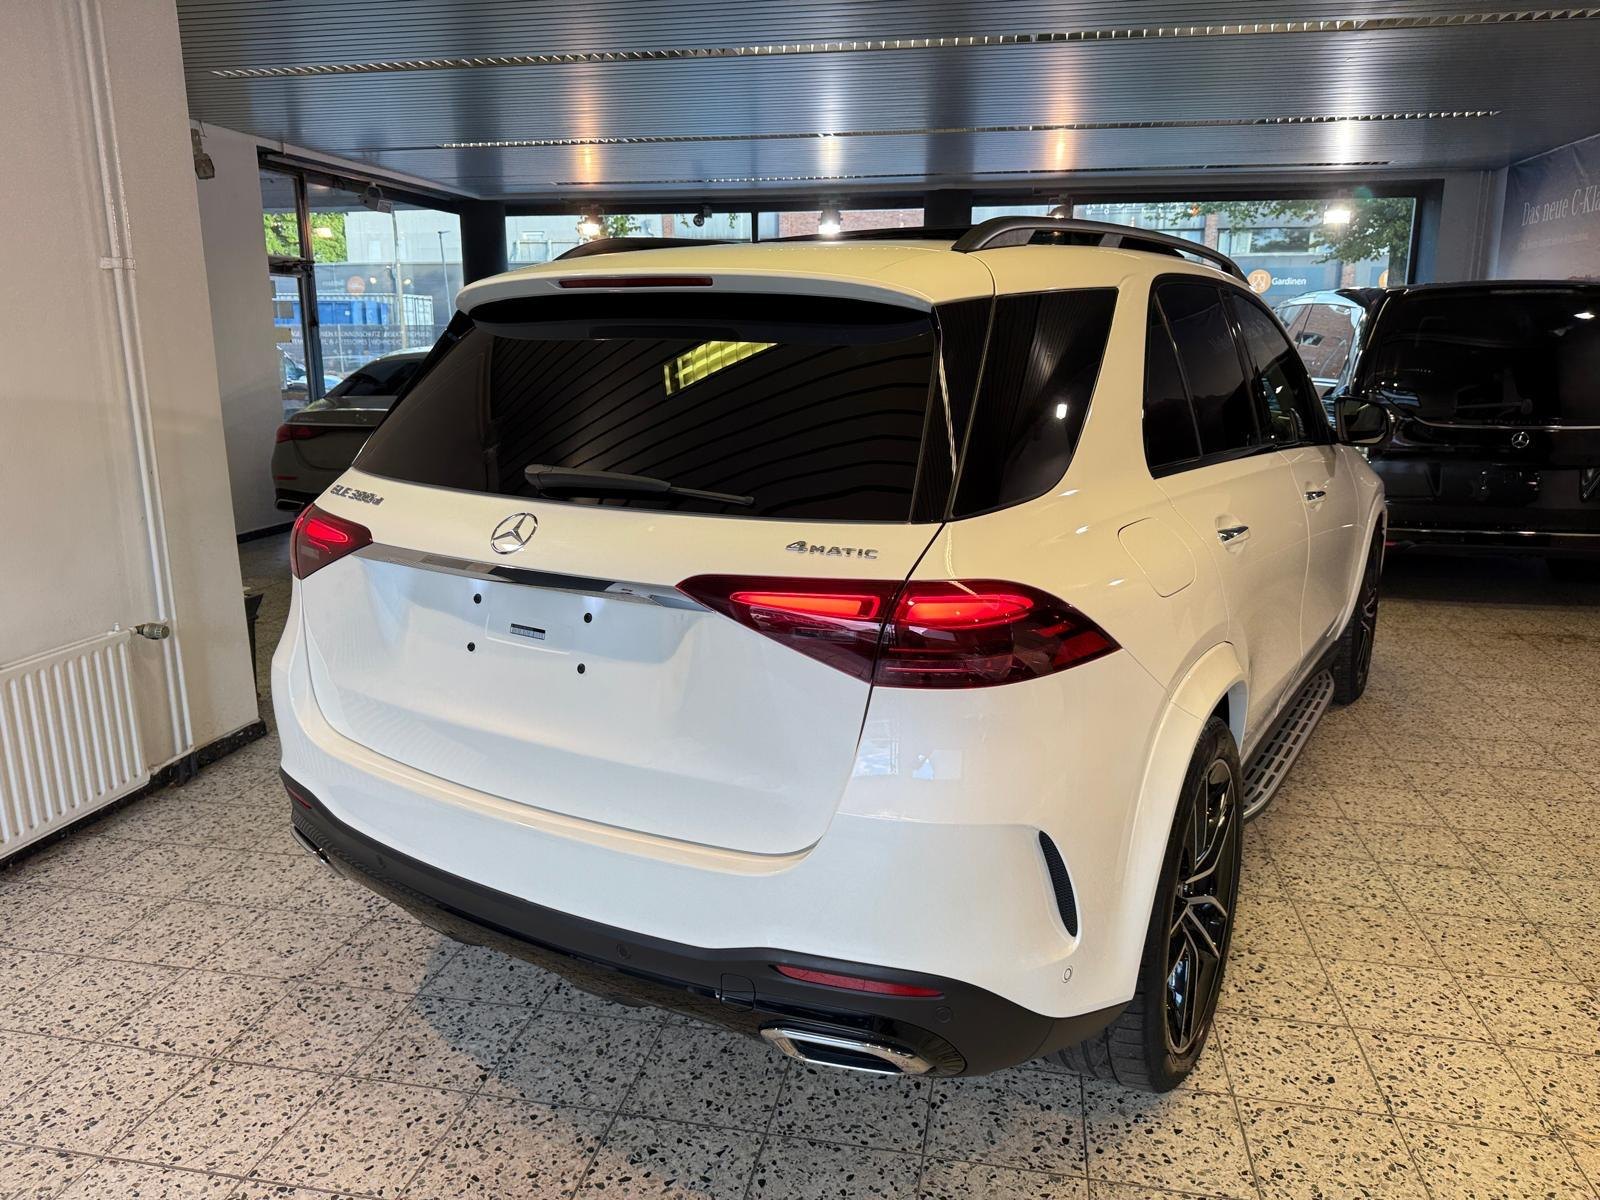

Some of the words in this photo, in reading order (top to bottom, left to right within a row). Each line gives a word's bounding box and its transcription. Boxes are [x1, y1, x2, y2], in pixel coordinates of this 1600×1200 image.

[1521, 202, 1540, 226] Das
[1542, 198, 1569, 221] neue
[1271, 277, 1307, 286] Gardinen
[785, 540, 879, 560] 4MATIC
